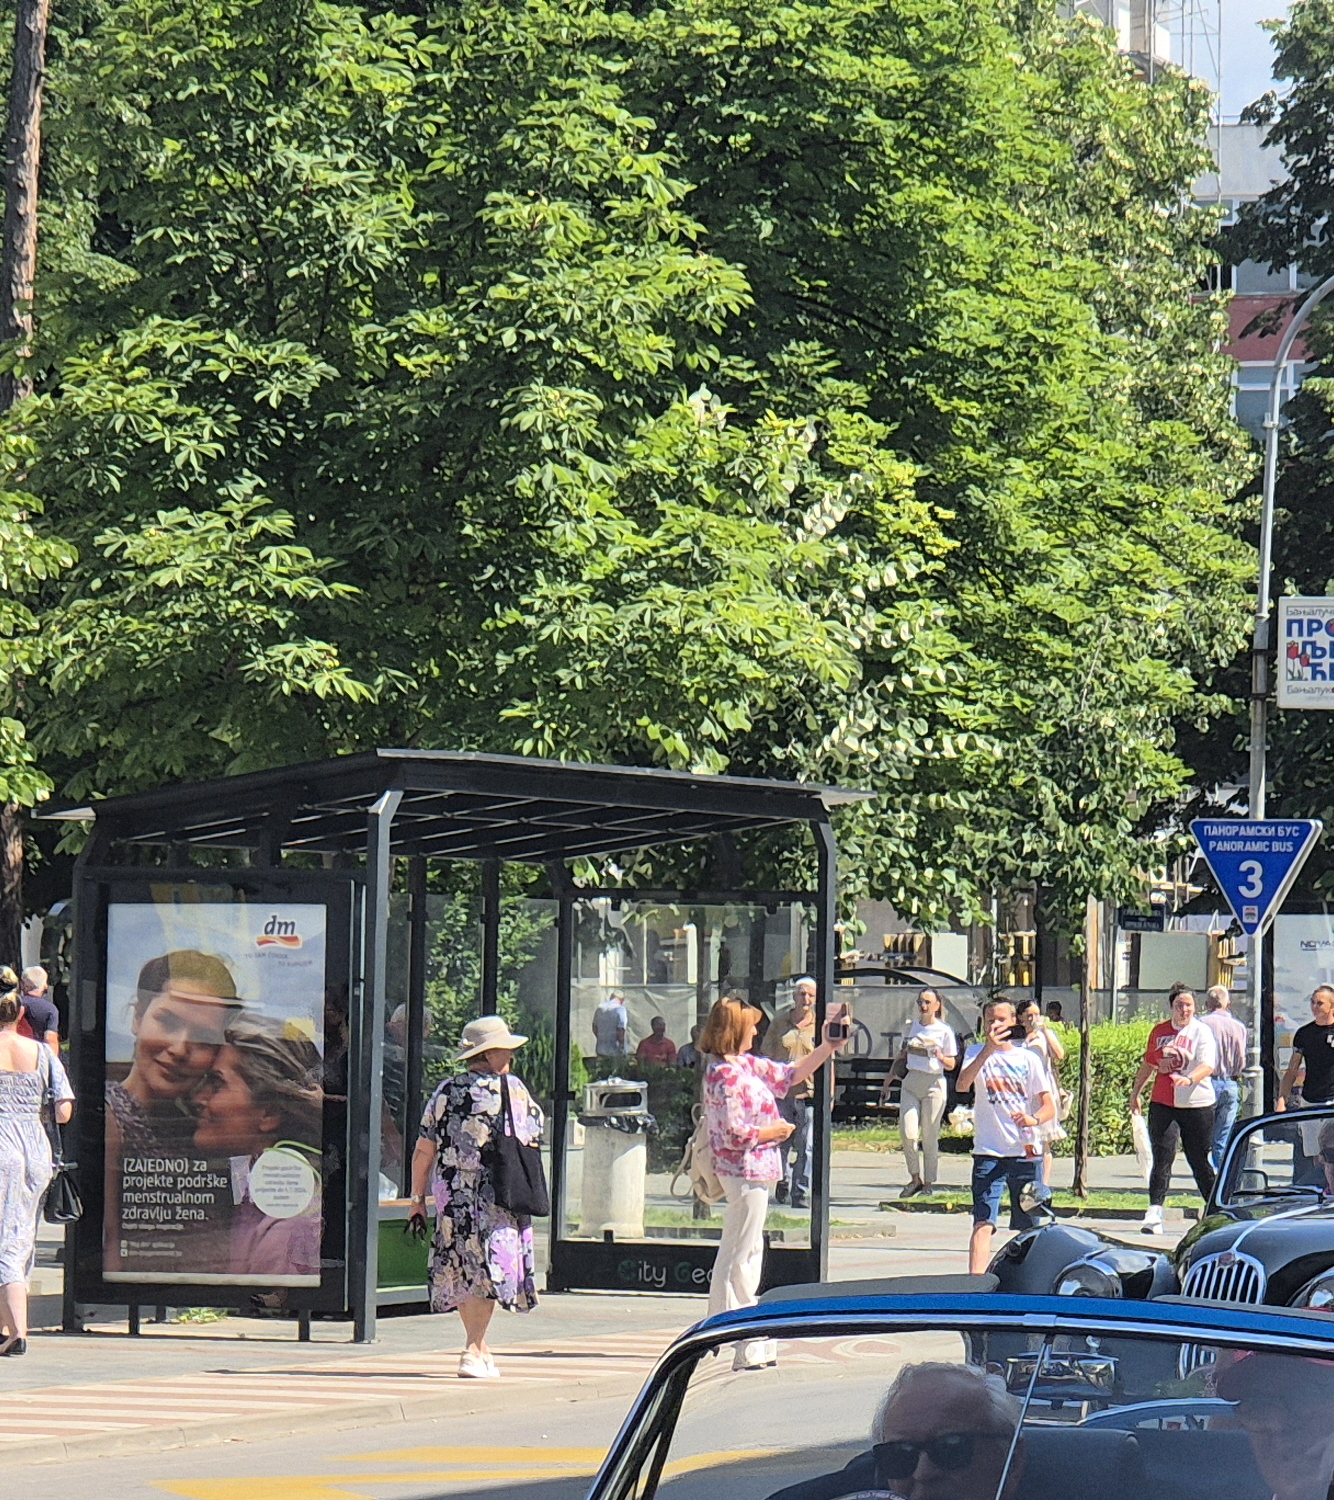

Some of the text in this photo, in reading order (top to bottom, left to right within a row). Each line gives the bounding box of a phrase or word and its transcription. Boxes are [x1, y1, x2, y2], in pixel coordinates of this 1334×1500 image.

[1203, 825, 1300, 837] ПАНОРАМСКИ БУС
[1208, 840, 1294, 852] PANORAMIC BUS
[1238, 860, 1263, 898] 3
[264, 914, 296, 935] dm
[192, 1160, 207, 1172] za
[122, 1173, 228, 1190] projekte podrške
[122, 1190, 215, 1204] menstrualnom
[122, 1206, 209, 1222] zdravlju žena.
[618, 1259, 667, 1288] City
